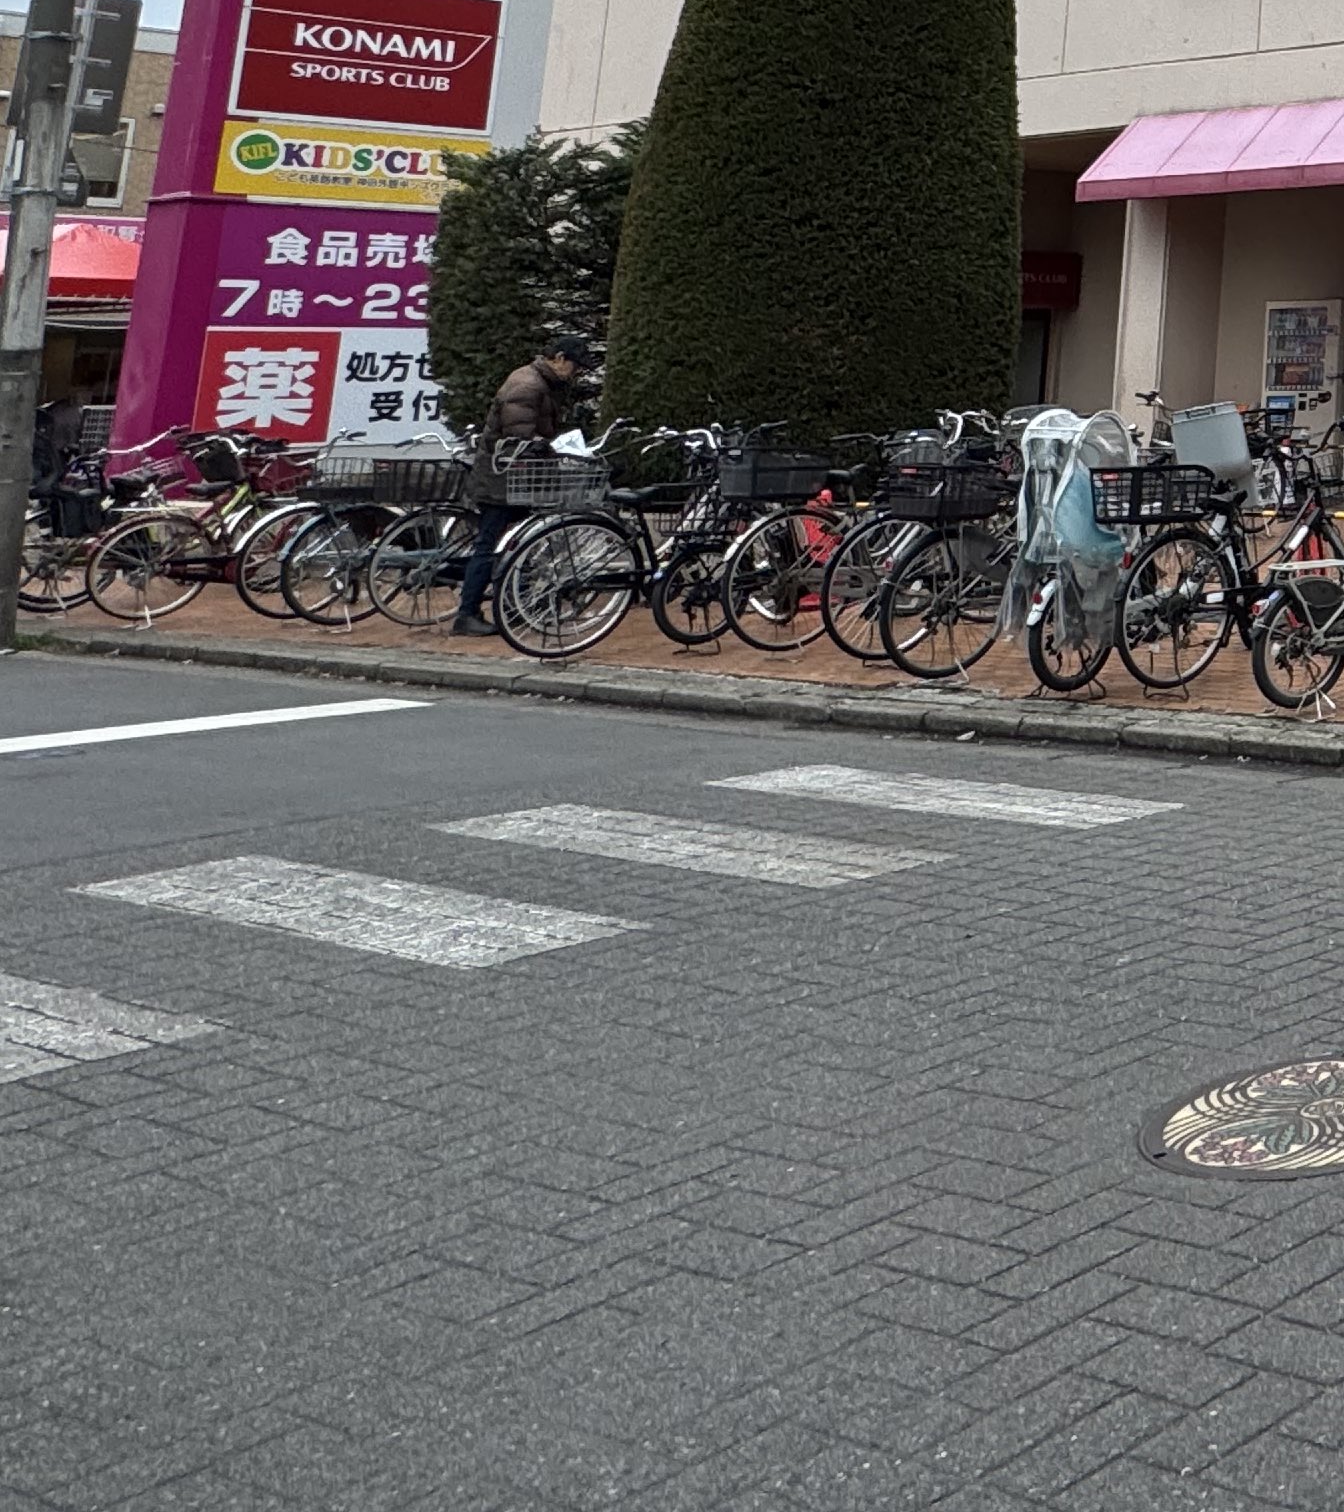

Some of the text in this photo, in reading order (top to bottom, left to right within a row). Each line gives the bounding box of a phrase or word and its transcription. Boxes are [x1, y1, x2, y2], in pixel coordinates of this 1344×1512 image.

[294, 23, 455, 63] KONAMI
[291, 62, 451, 92] SPORTS CLUB
[215, 347, 321, 428] 薬
